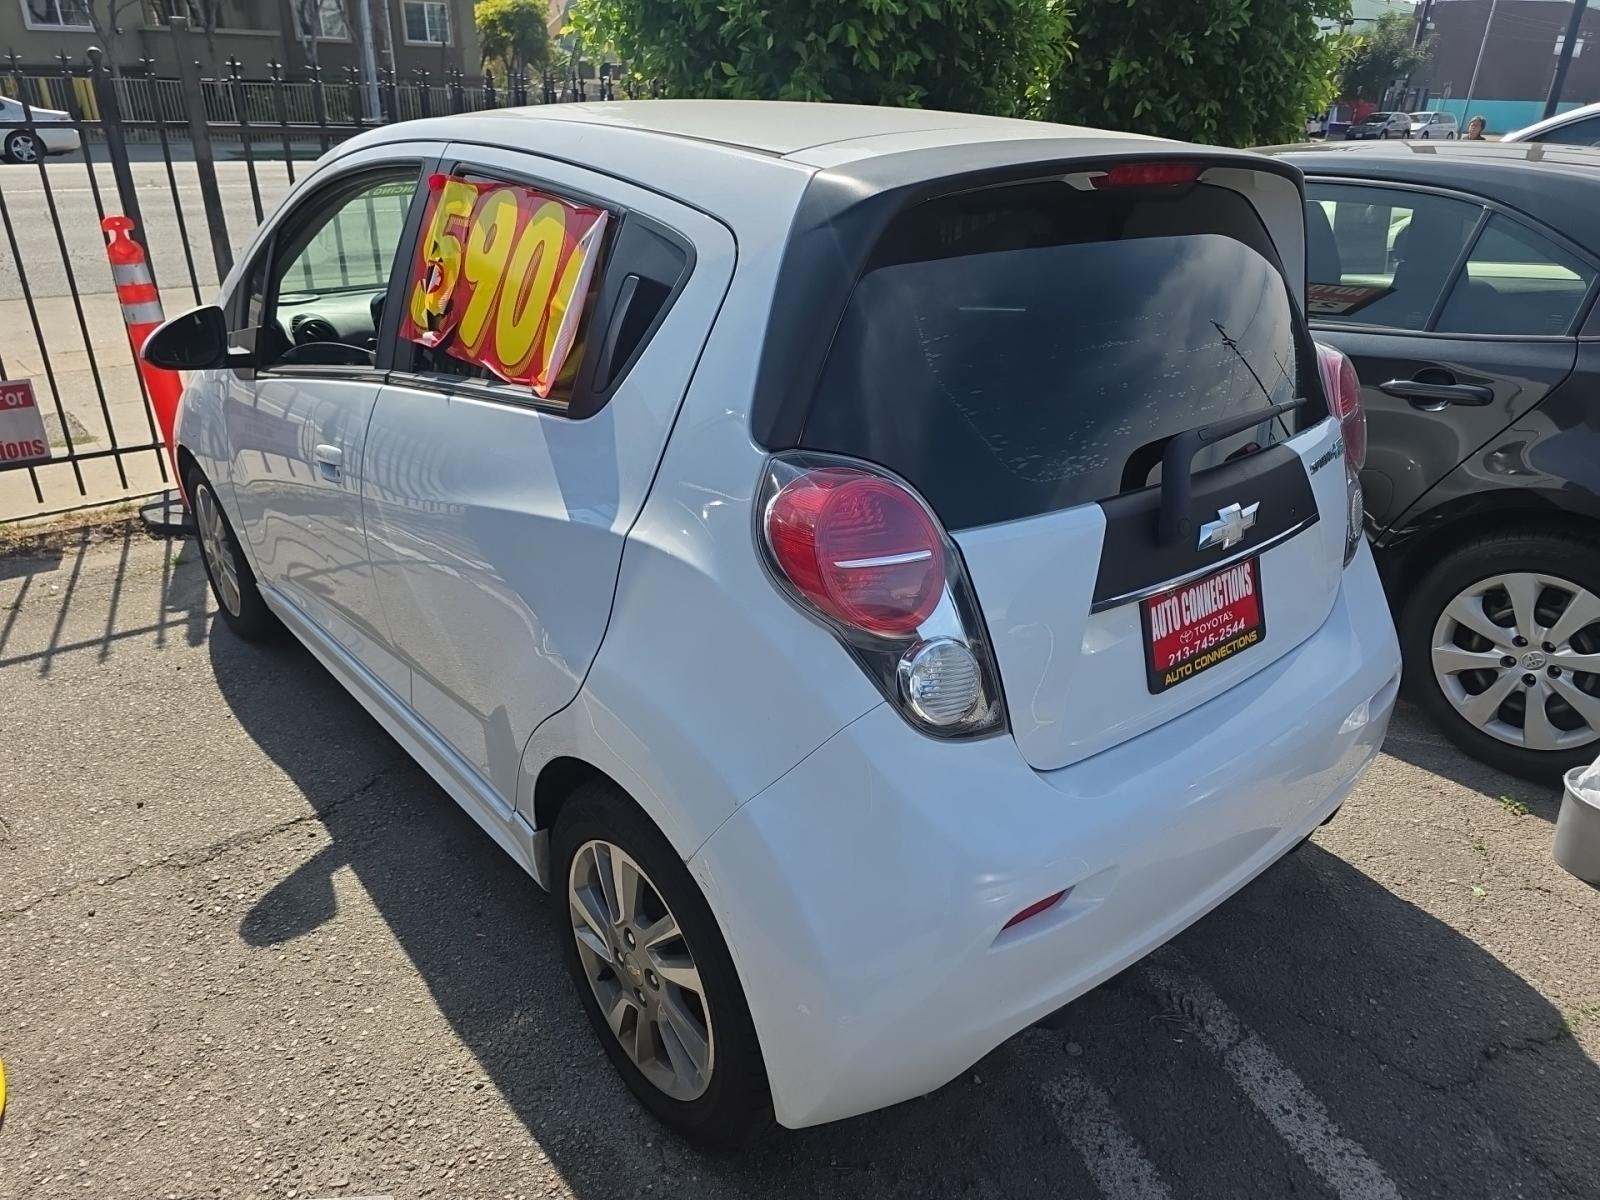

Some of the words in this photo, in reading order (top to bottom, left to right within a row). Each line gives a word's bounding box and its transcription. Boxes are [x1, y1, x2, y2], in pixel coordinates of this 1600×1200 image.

[1151, 596, 1181, 642] AUTO
[1181, 562, 1253, 626] CONNECTIONS
[1165, 664, 1192, 686] AUTO
[1194, 630, 1258, 671] CONNECTIONS
[1168, 617, 1246, 667] 213-745-2544
